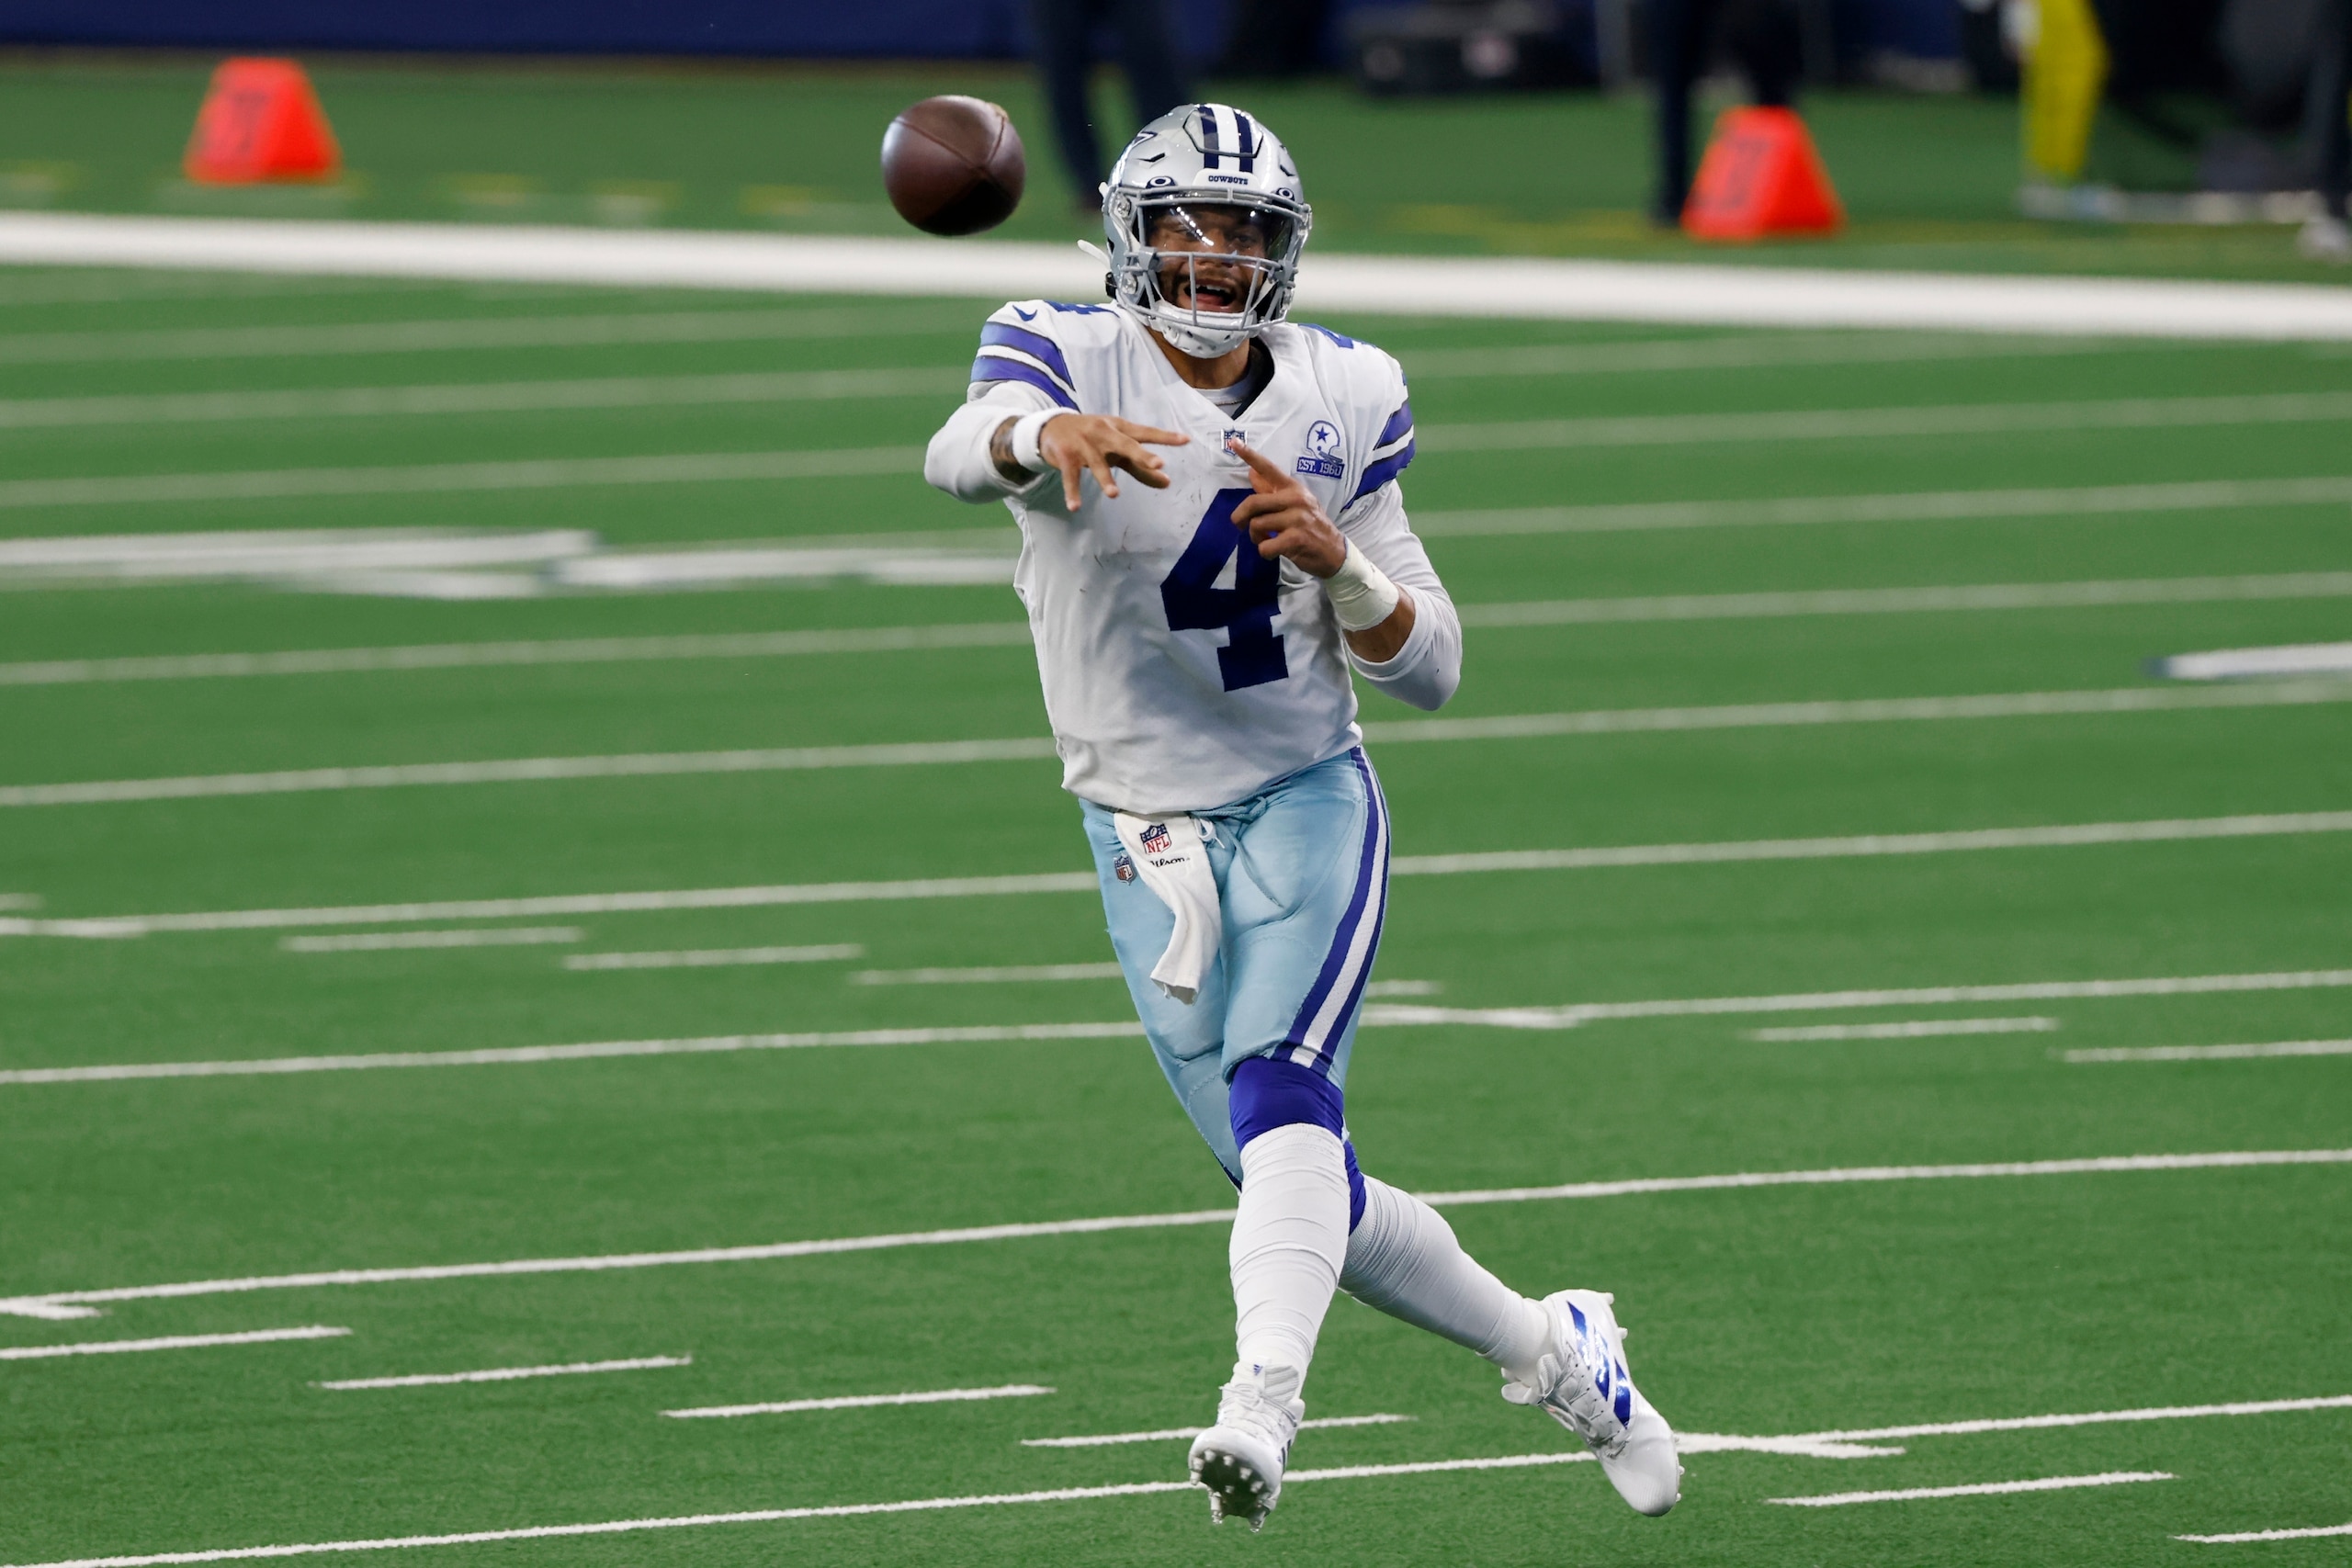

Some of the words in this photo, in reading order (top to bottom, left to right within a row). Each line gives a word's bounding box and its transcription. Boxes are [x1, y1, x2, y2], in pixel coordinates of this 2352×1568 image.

[1208, 175, 1249, 185] COWBOYS
[1297, 459, 1316, 472] EST.
[1319, 462, 1342, 476] 1960
[1160, 489, 1289, 692] 4
[1146, 835, 1170, 853] NFL
[1117, 865, 1132, 879] NFL
